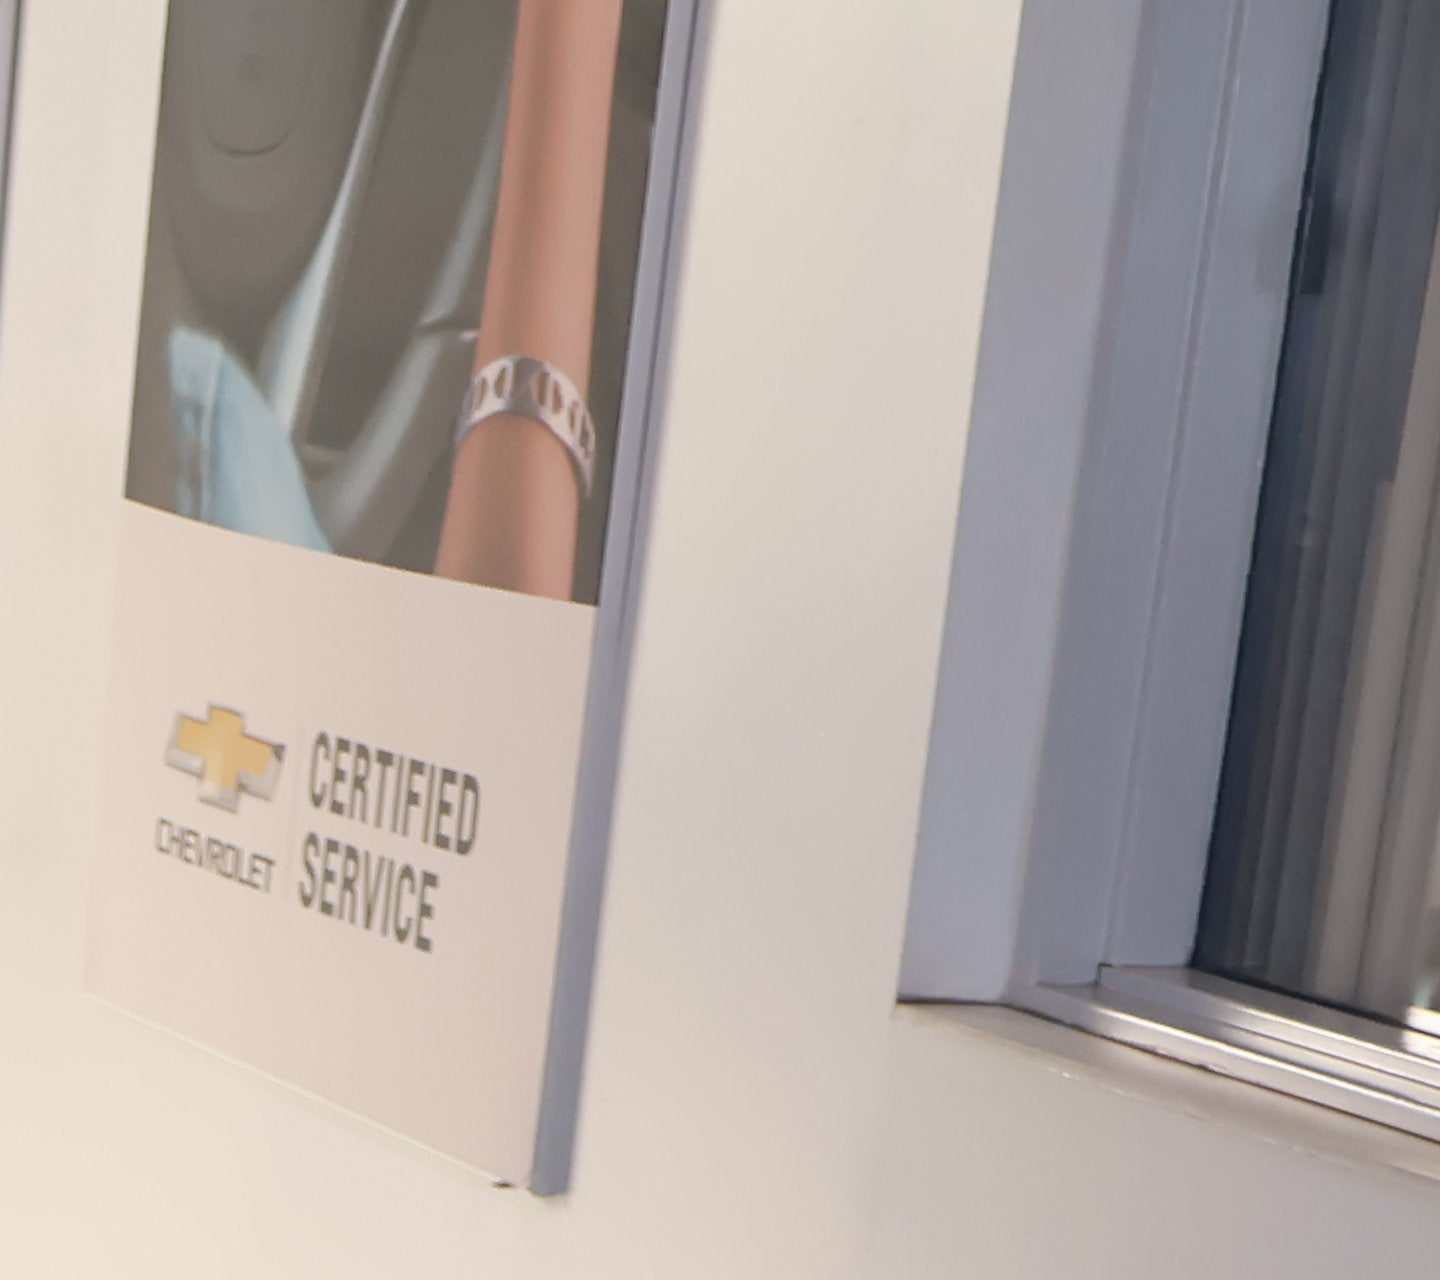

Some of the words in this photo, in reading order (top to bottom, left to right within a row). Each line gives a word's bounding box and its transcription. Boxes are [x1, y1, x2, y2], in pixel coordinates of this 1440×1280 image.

[153, 815, 276, 893] CHEVROLET
[309, 729, 481, 857] CERTIFIED
[297, 829, 441, 955] SERVICE
